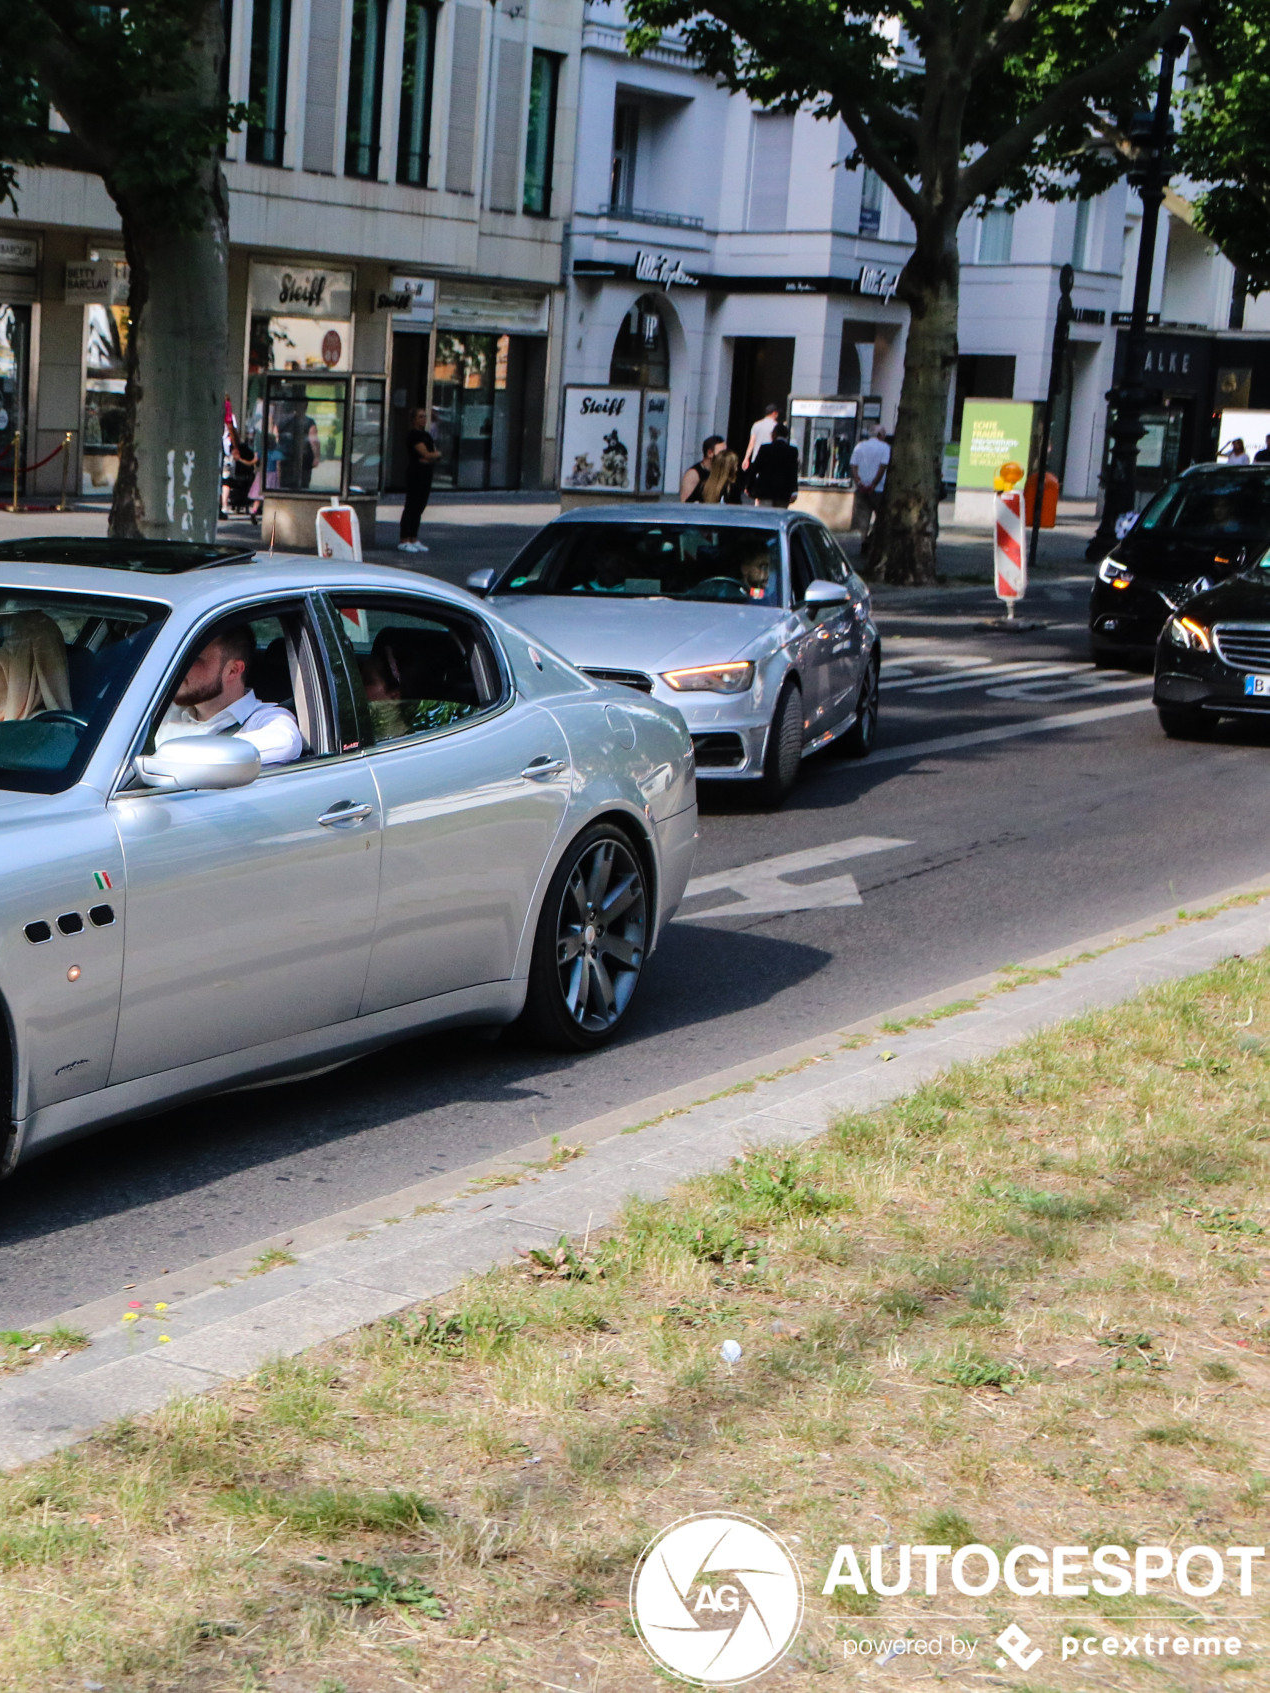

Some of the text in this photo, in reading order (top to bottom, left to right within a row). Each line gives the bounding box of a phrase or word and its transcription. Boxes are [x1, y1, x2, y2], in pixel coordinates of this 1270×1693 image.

[0, 244, 32, 256] BARCLAY
[68, 268, 95, 278] BETTY
[67, 280, 109, 289] BARCLAY
[279, 273, 326, 307] Steiff
[1144, 350, 1191, 374] ALKE
[580, 397, 626, 416] Steiff
[973, 420, 998, 430] ECHTE
[972, 430, 1004, 439] FRAUEN
[1254, 678, 1264, 692] B
